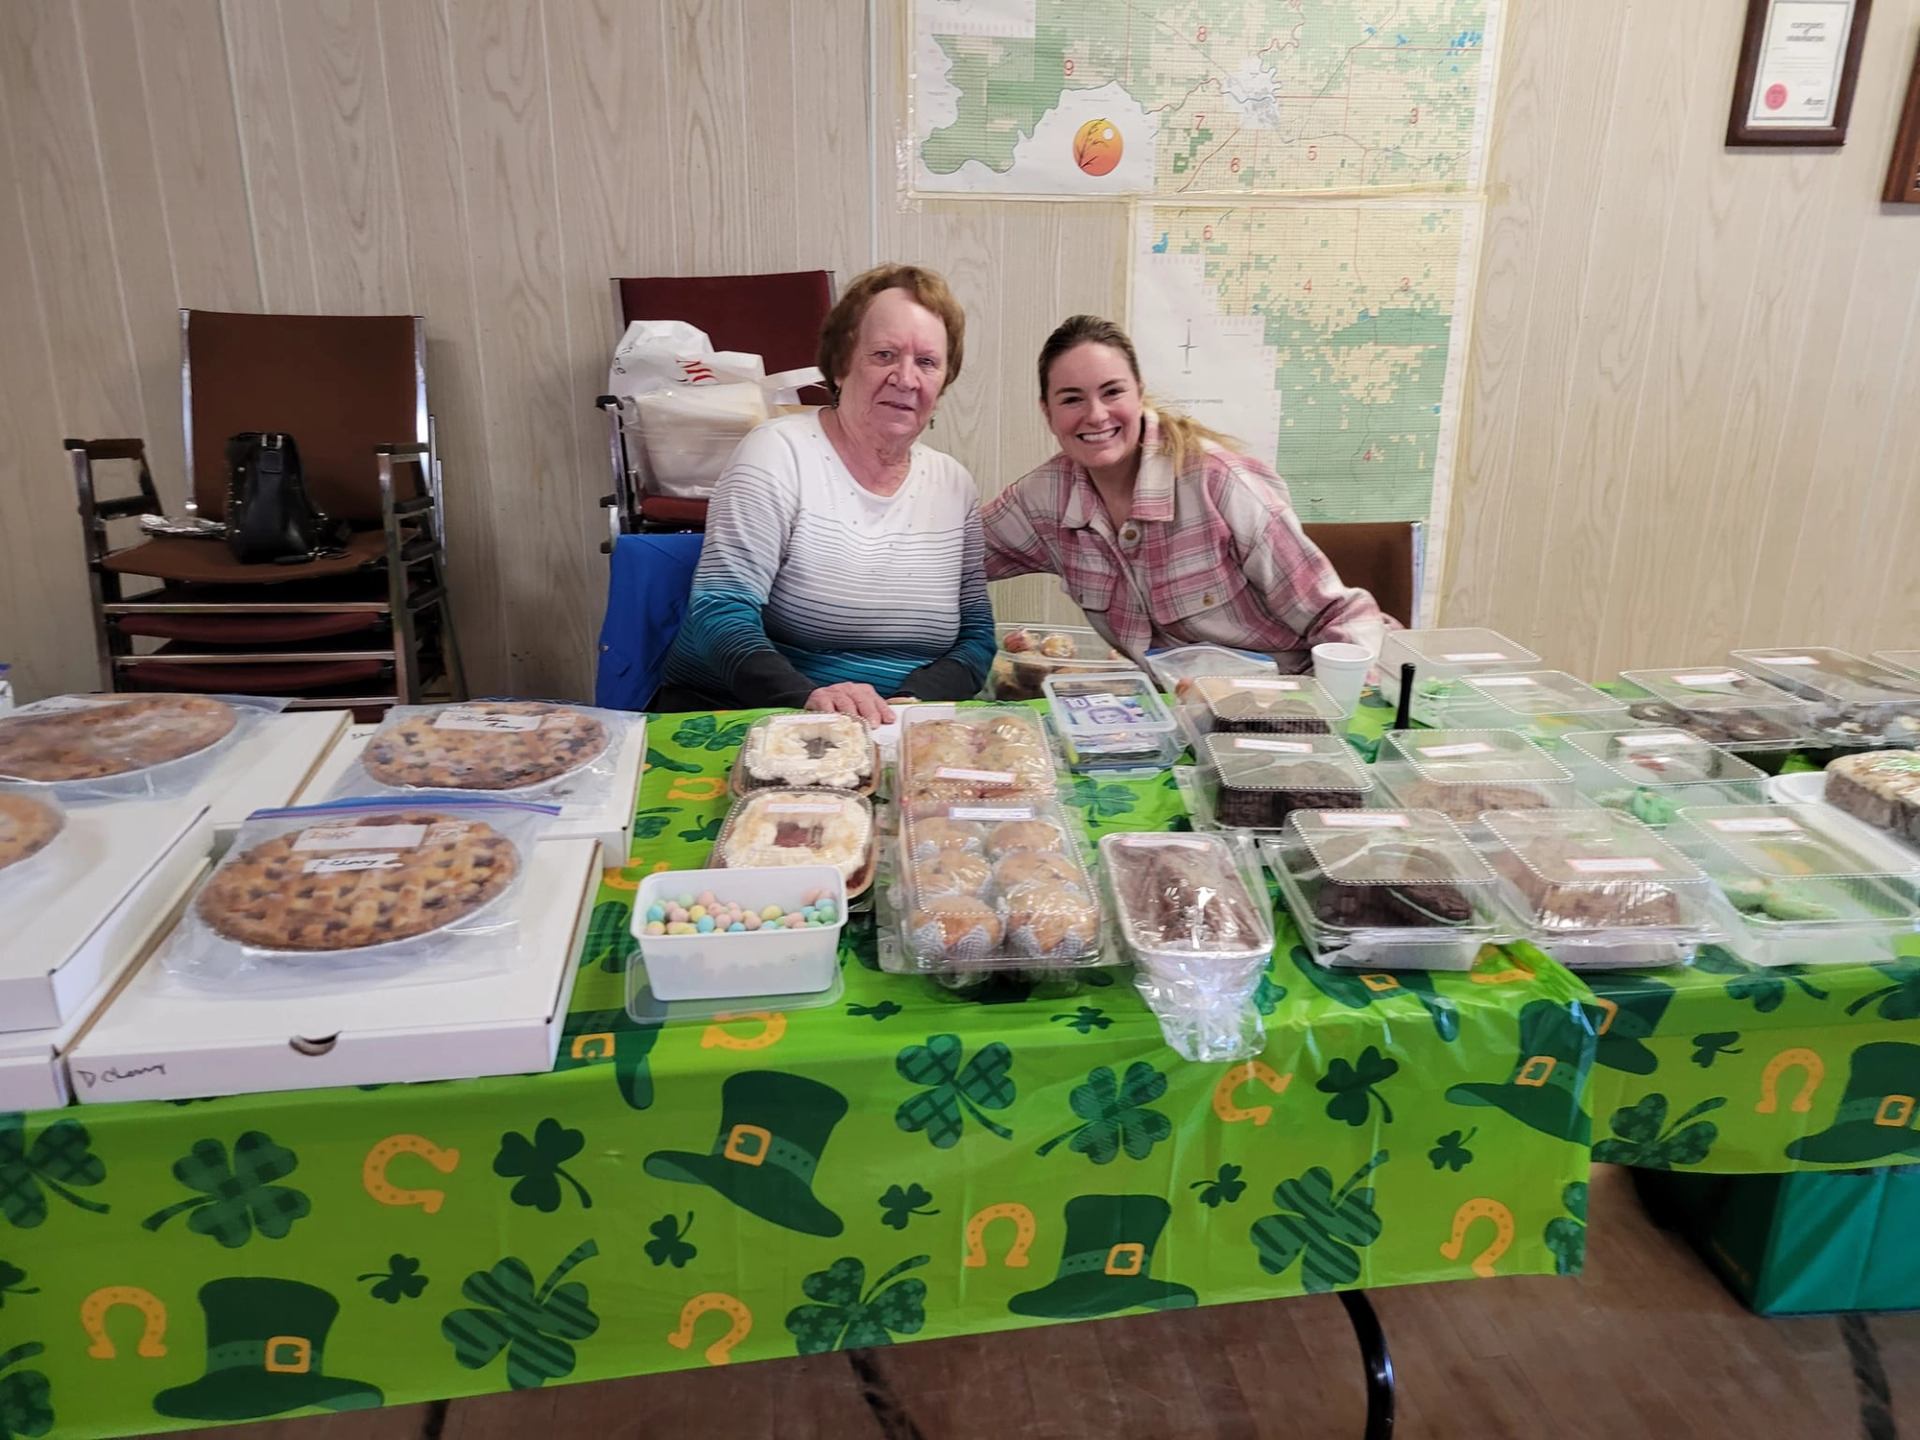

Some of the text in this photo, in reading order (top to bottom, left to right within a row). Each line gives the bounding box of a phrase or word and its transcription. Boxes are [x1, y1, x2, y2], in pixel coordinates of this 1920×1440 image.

[1197, 26, 1207, 42] 8
[1063, 59, 1074, 76] 9
[1194, 115, 1206, 131] 7
[1409, 107, 1419, 125] 3
[1307, 145, 1318, 161] 5
[1230, 157, 1241, 173] 6
[1202, 224, 1213, 240] 6
[1303, 278, 1312, 294] 4
